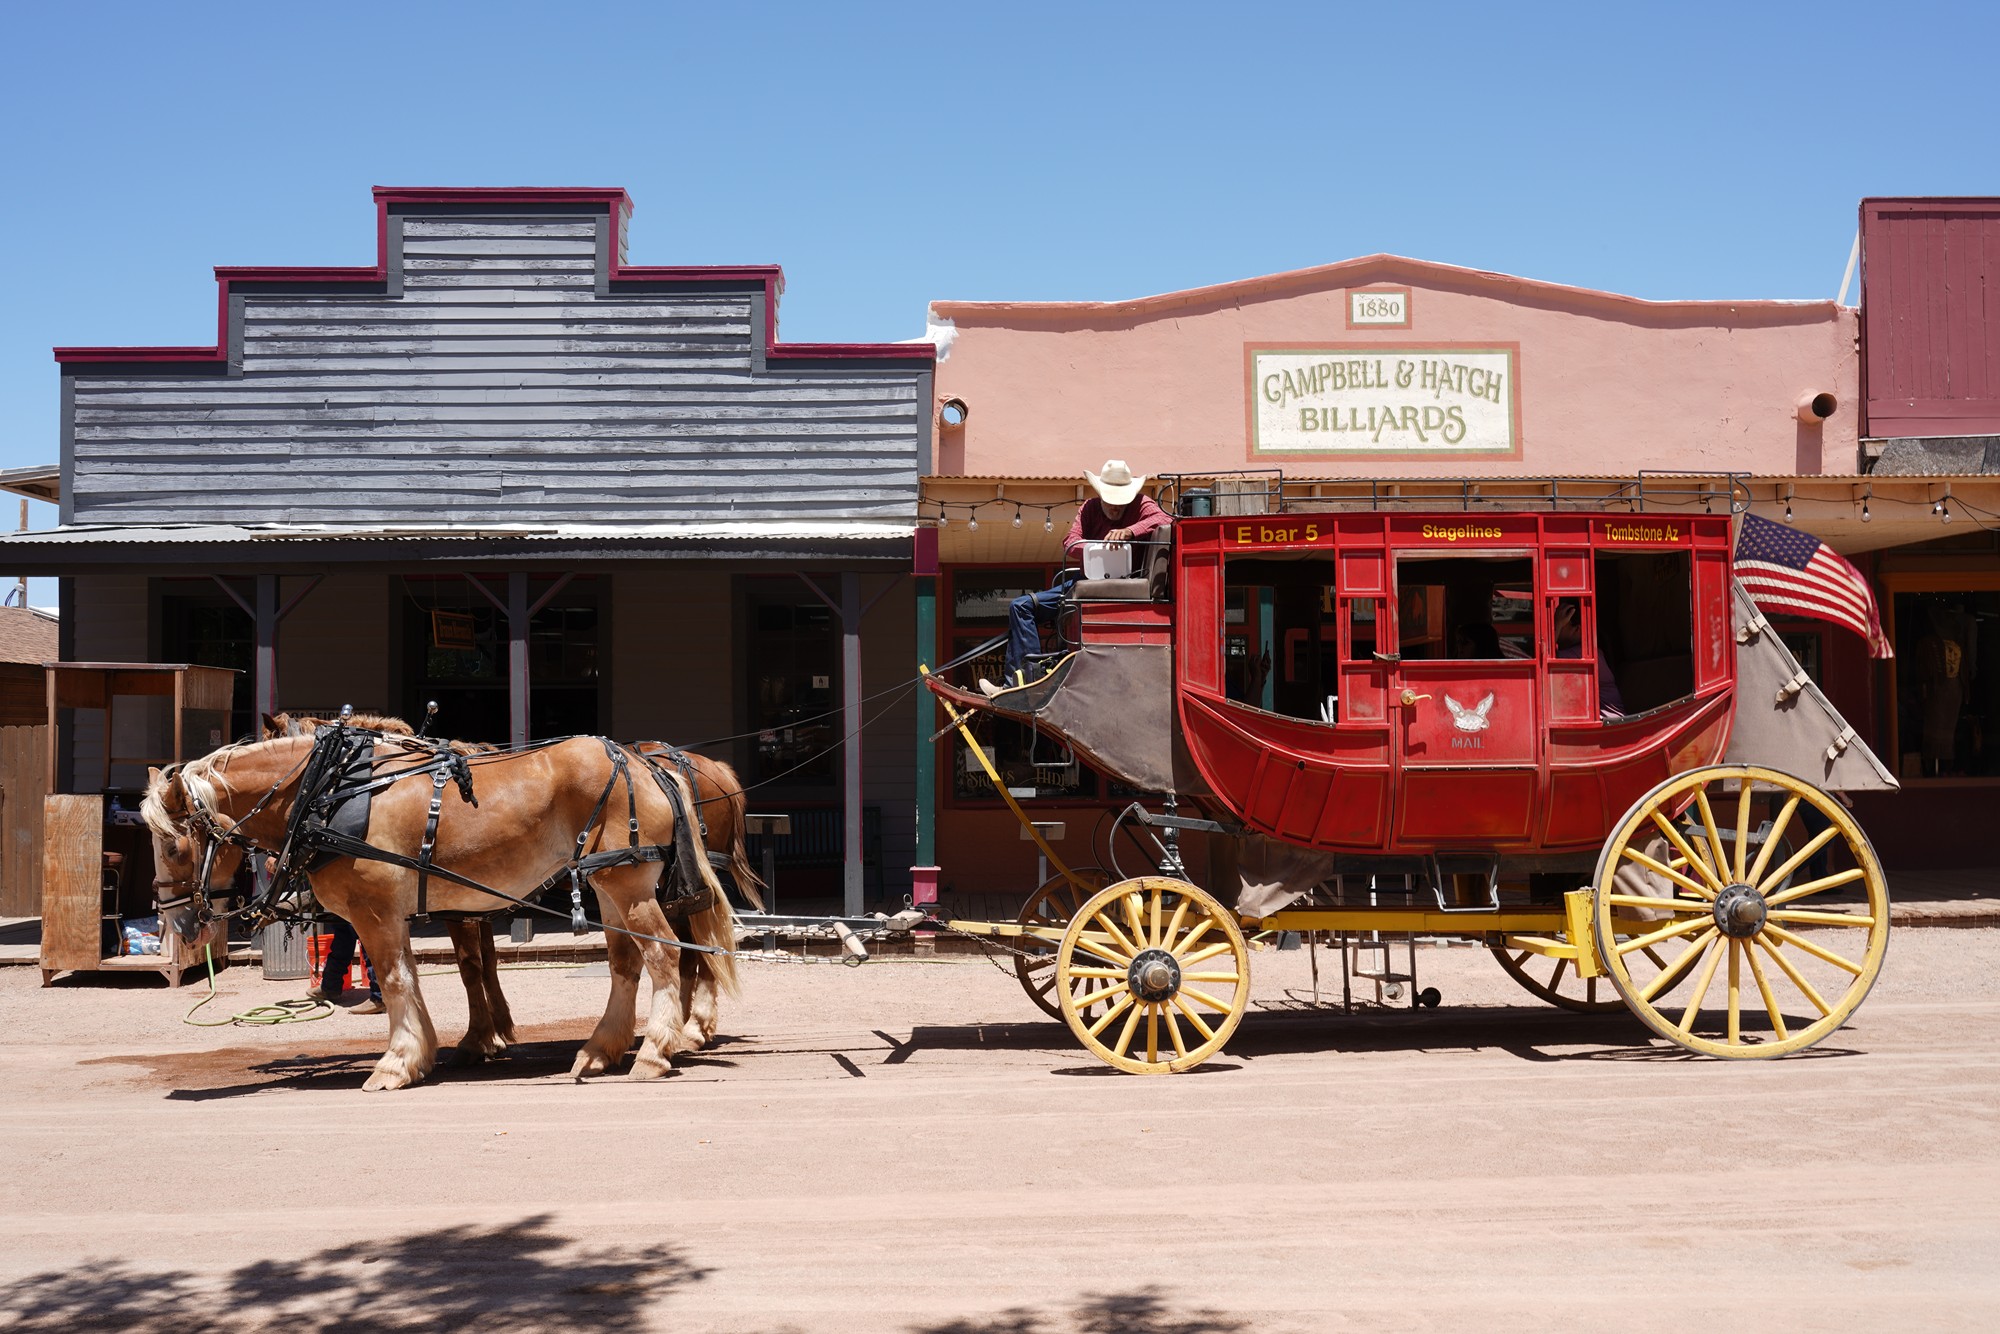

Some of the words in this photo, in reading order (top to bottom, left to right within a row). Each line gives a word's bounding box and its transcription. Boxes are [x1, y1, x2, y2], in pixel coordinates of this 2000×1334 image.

[1358, 300, 1400, 317] 1880
[1263, 359, 1388, 408] CAMPBELL
[1395, 359, 1415, 388] &
[1421, 359, 1502, 404] HATCH
[1300, 405, 1466, 444] BILLIARDS
[1237, 526, 1252, 543] E
[1260, 526, 1298, 543] bar
[1305, 524, 1318, 541] 5
[1422, 524, 1502, 541] Stagelines
[1604, 523, 1663, 541] Tombstone
[1664, 524, 1679, 541] Az
[1451, 737, 1485, 749] MAIL
[967, 770, 1015, 790] SKULS
[1036, 767, 1080, 788] HIDE
